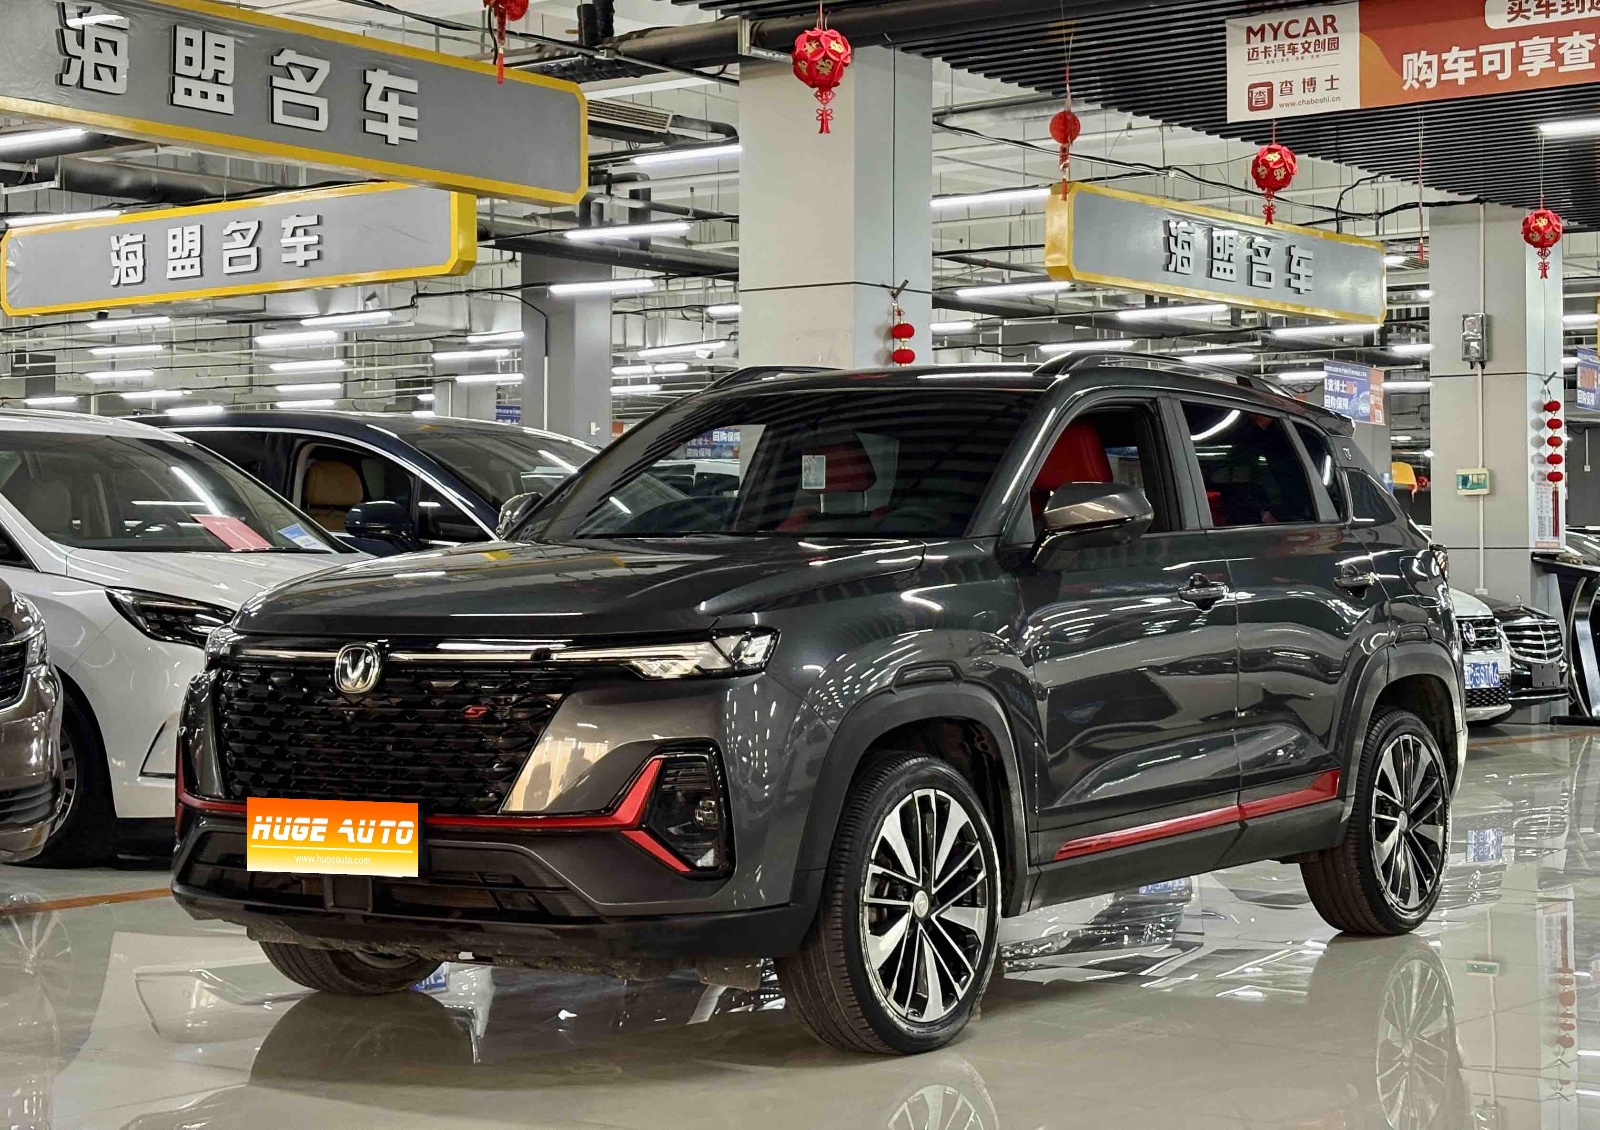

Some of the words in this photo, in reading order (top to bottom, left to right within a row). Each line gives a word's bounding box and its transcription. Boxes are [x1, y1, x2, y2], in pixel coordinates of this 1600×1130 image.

[1245, 14, 1339, 45] MYCAR
[1247, 36, 1340, 62] 迈卡汽车文创园
[56, 1, 419, 146] 海盟名车
[1402, 30, 1600, 91] 购车可享查
[1278, 96, 1341, 109] www.chaboshi.cn
[110, 214, 323, 287] 海盟名车
[1163, 219, 1314, 295] 海盟名车
